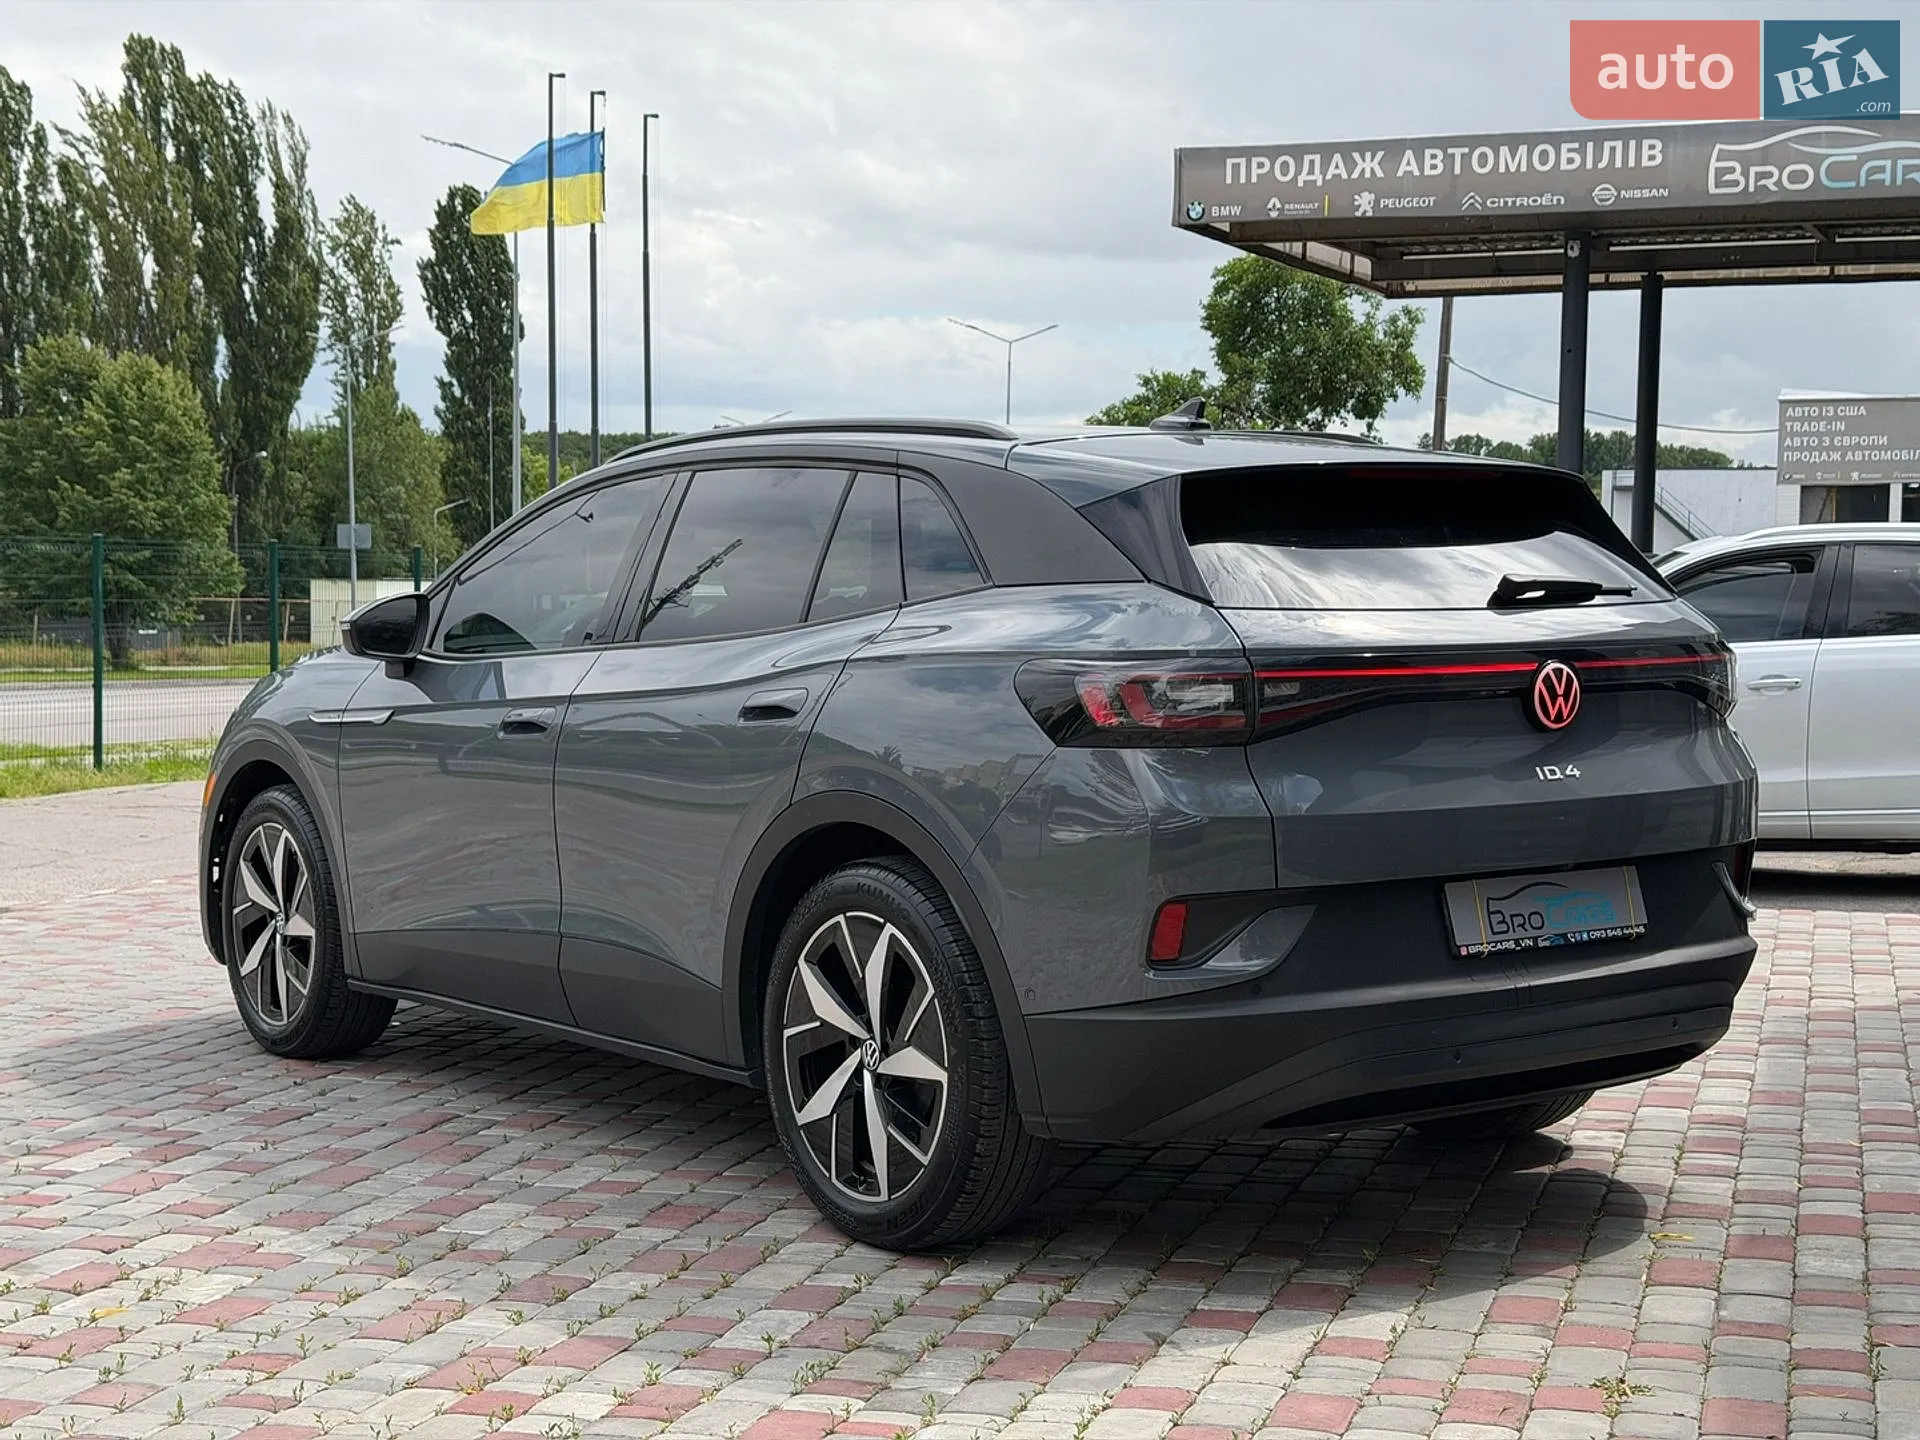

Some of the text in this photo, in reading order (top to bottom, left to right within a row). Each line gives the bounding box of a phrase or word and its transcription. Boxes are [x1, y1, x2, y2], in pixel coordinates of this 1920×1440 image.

[1225, 138, 1663, 187] ПРОДАЖ АВТОМОБІЛІВ
[1620, 188, 1669, 199] NISSAN
[1380, 197, 1436, 209] PEUGEOT
[1211, 206, 1242, 217] BMW
[1786, 406, 1819, 417] АВТО
[1837, 406, 1867, 416] США
[1785, 421, 1846, 433] TRADE-IN
[1784, 437, 1818, 447] АВТО
[1834, 435, 1888, 446] ЄВРОПИ
[1784, 451, 1841, 463] ПРОДАЖ
[1536, 764, 1581, 780] ID.4
